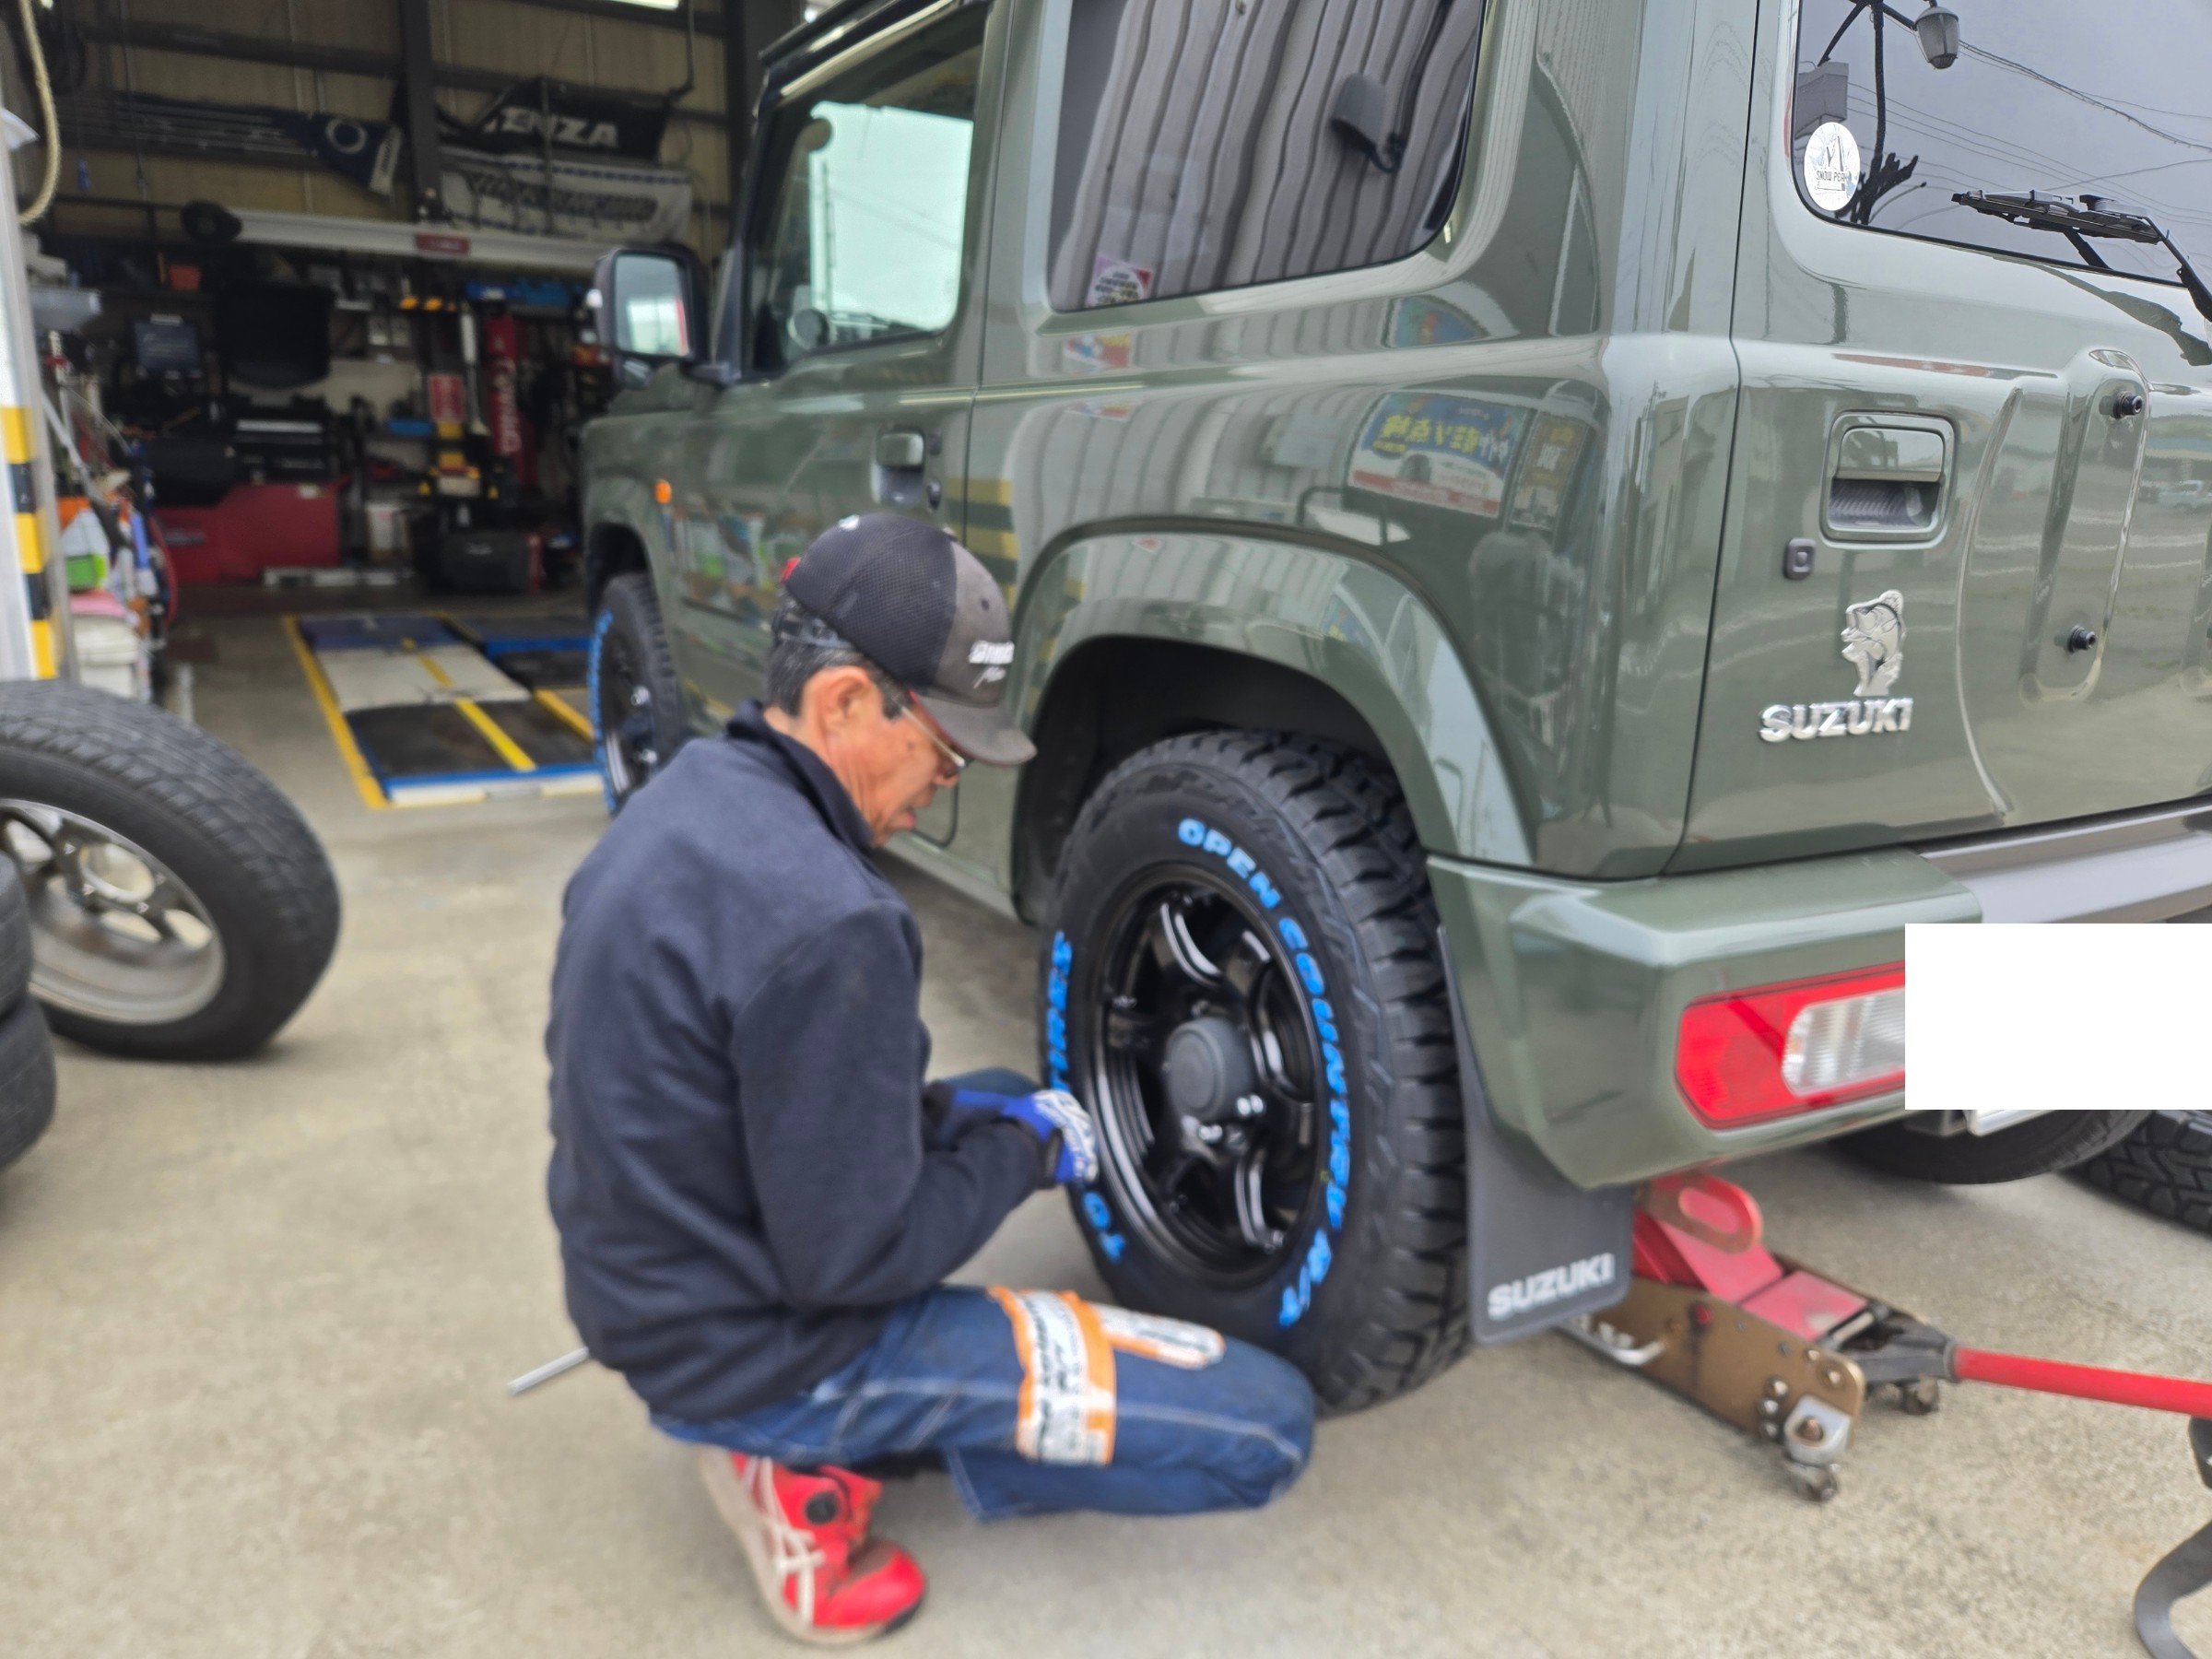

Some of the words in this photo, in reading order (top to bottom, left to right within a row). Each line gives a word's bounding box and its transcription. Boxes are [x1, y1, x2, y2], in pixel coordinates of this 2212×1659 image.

[482, 106, 618, 147] ENZA
[1759, 698, 1914, 743] SUZUKI
[1177, 818, 1282, 910] OPEN
[1487, 1252, 1616, 1322] SUZUKI
